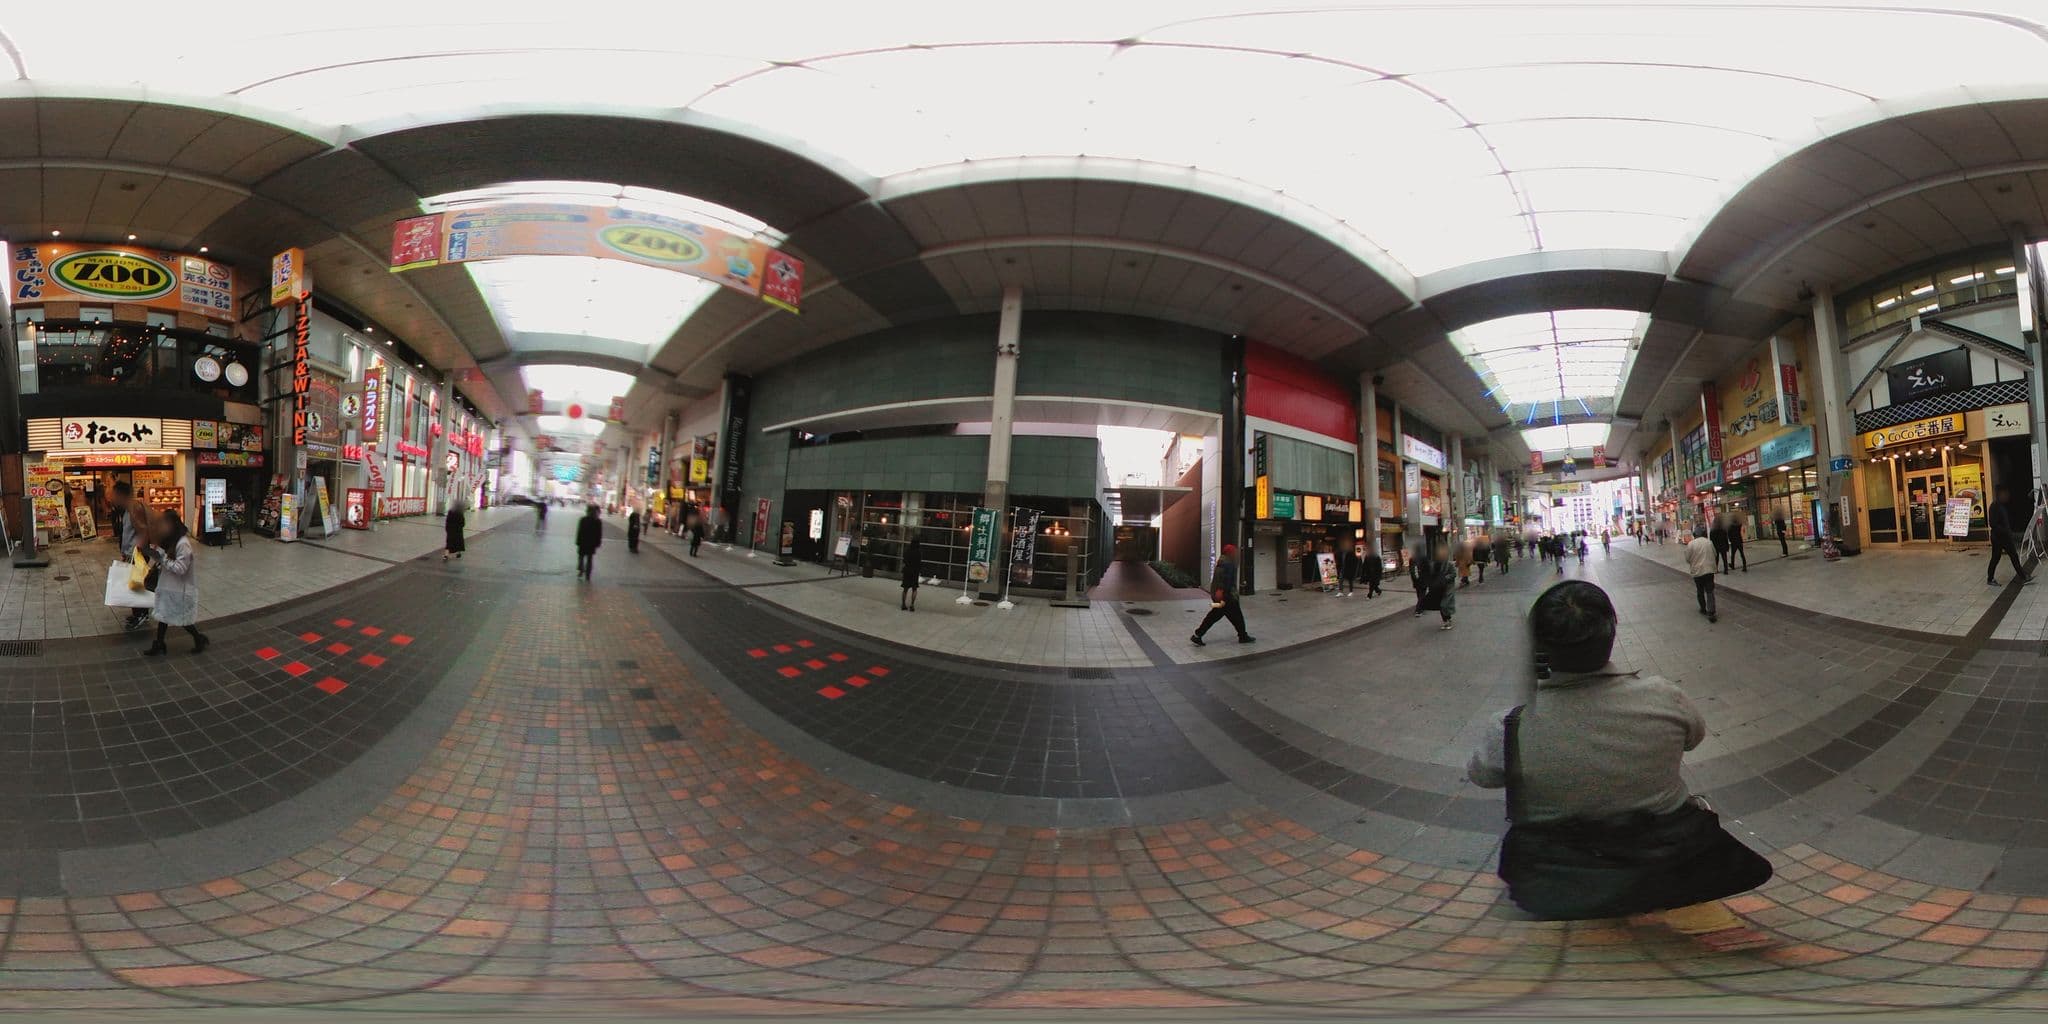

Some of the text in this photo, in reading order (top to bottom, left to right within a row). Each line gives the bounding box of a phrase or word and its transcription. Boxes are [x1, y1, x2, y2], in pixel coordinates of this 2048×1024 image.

[74, 262, 161, 286] ZOO
[85, 421, 154, 445] 松のや
[1888, 418, 1953, 443] CoCo壱番屋
[344, 445, 363, 459] 123
[727, 466, 738, 491] Hotel
[975, 513, 990, 560] 郷土料理
[1013, 525, 1028, 561] 居酒屋
